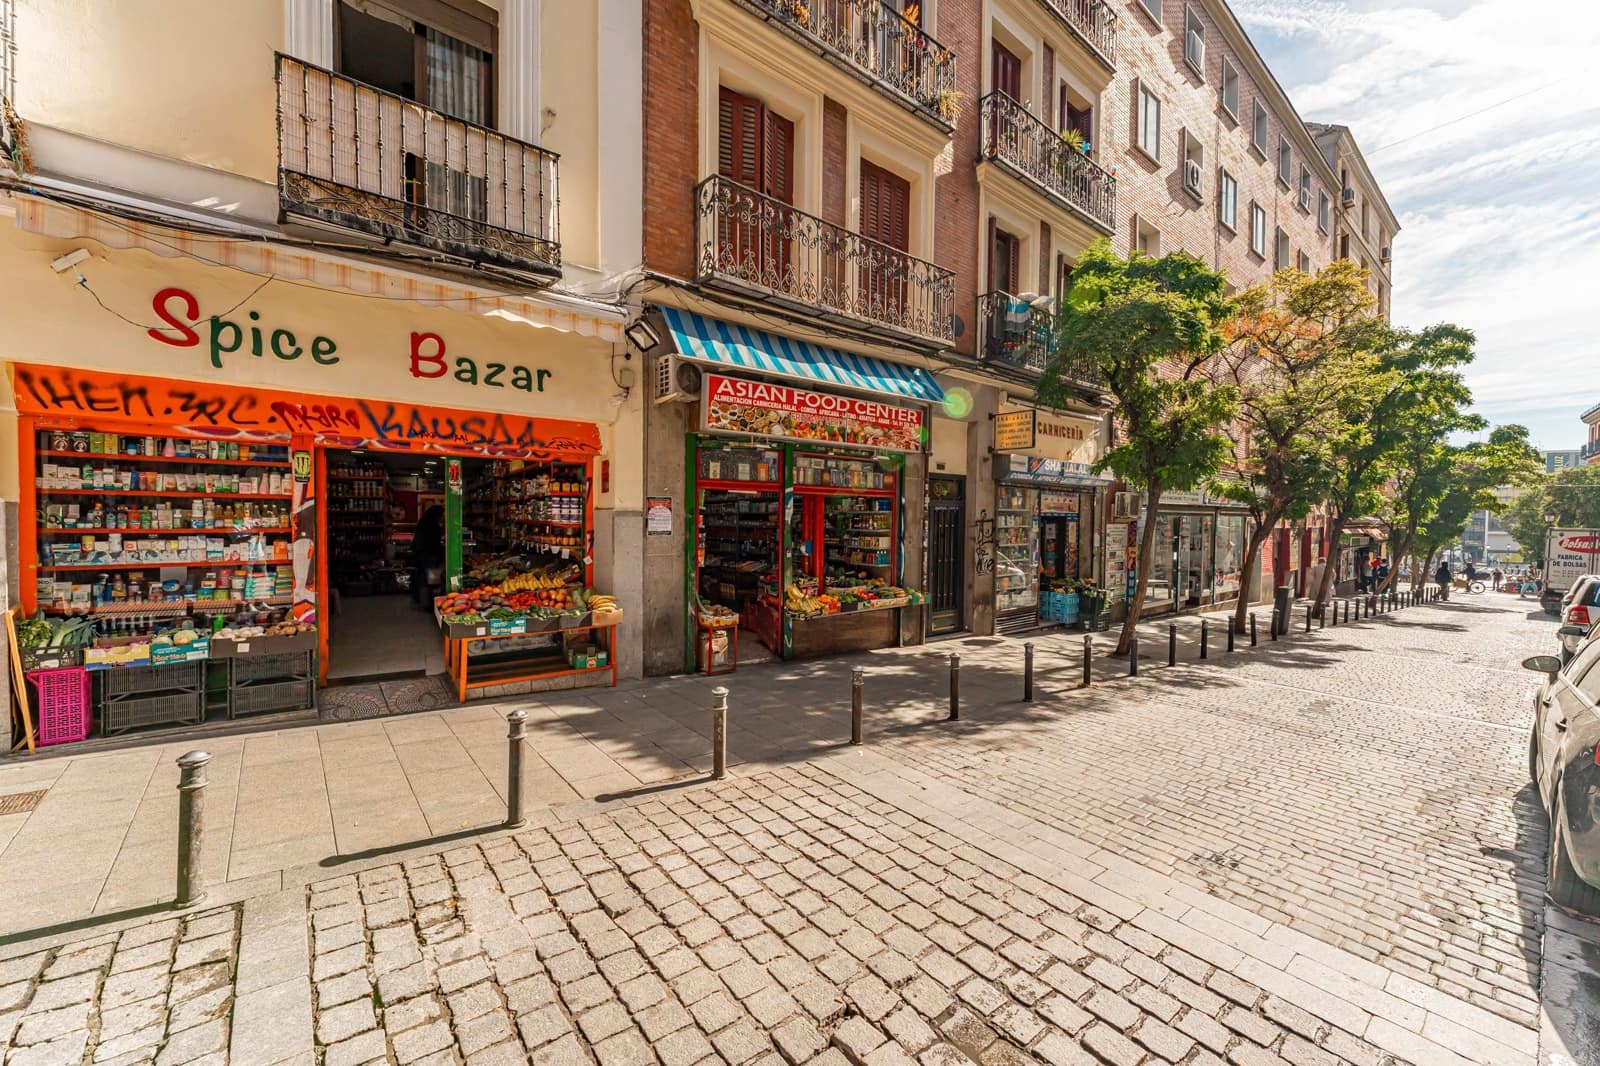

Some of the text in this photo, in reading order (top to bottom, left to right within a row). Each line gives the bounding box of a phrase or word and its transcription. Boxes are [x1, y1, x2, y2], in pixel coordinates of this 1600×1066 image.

[147, 287, 552, 393] Spice Bazar
[716, 379, 787, 402] ASIAN
[793, 391, 850, 411] FOOD
[855, 401, 918, 423] CENTER
[782, 403, 797, 411] HALAL
